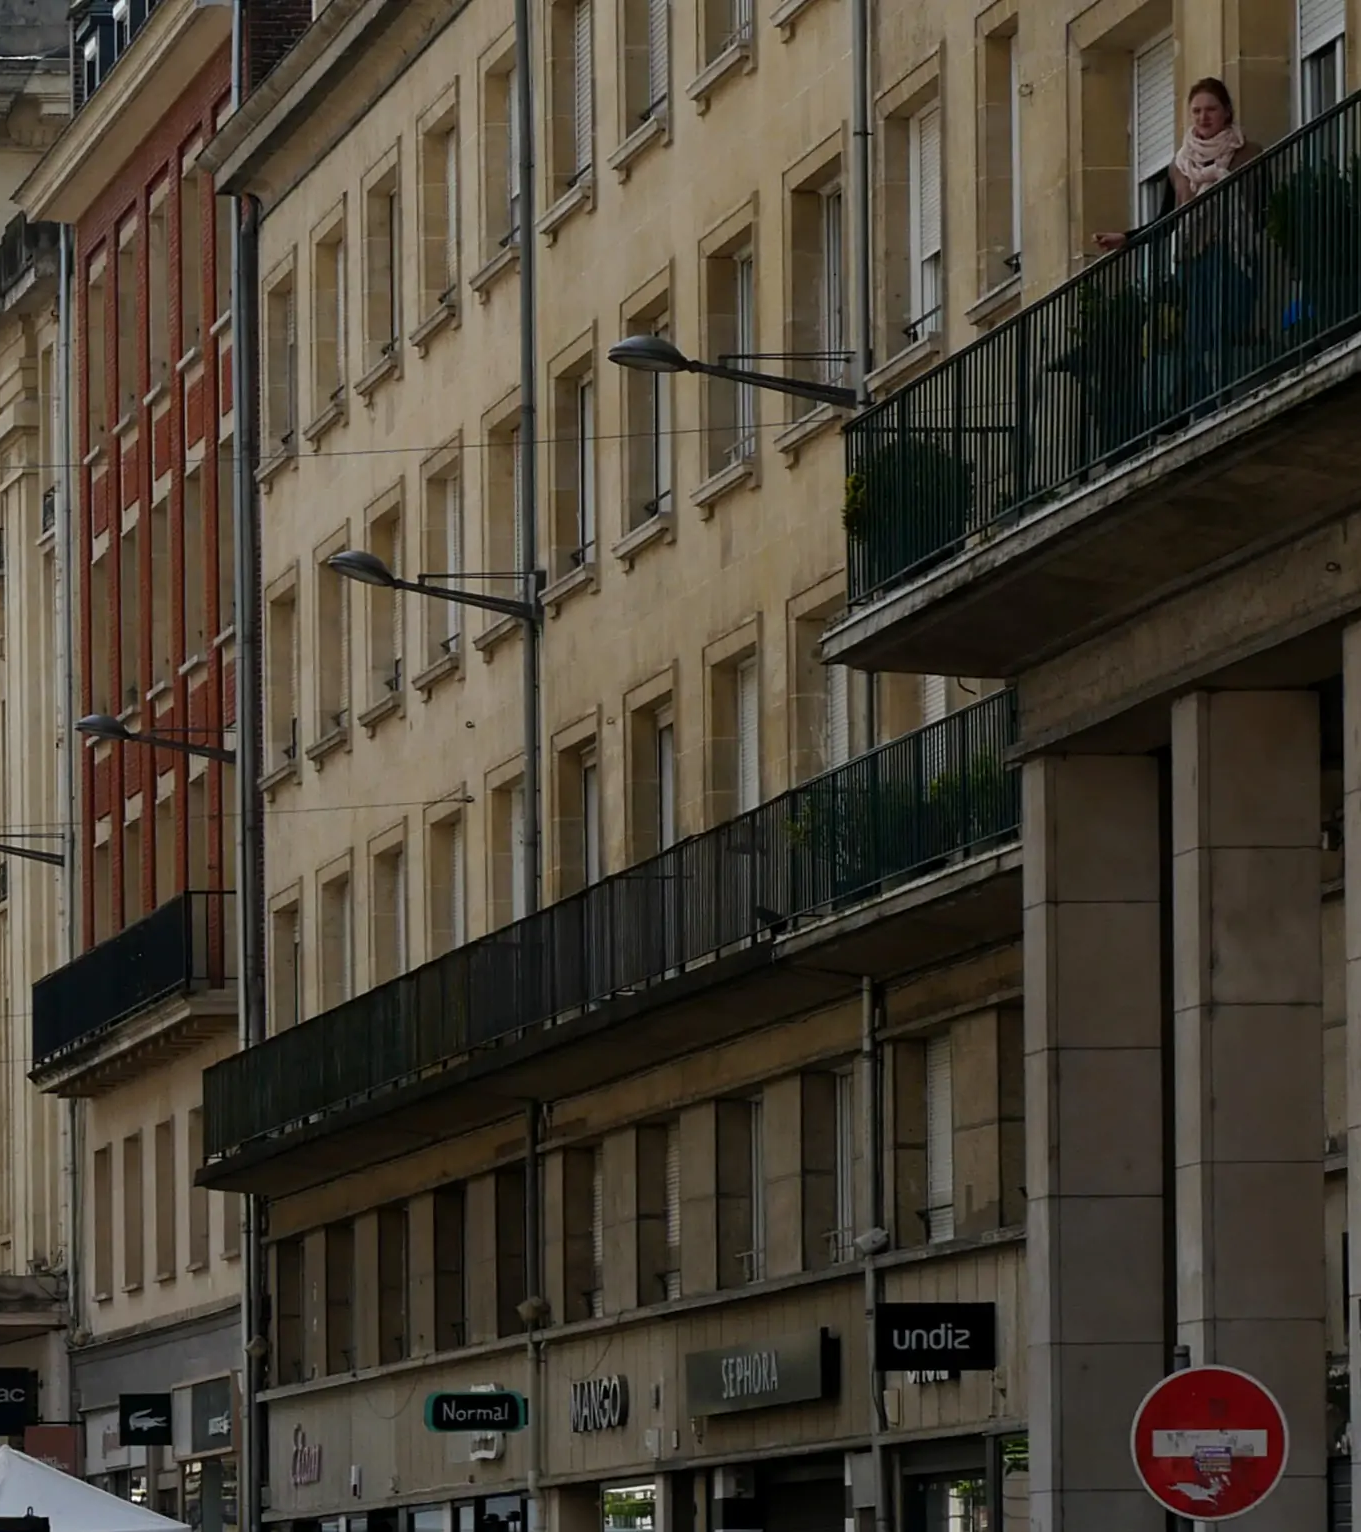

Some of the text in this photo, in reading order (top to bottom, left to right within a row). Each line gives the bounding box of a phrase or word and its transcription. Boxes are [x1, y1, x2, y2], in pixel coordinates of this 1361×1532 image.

[893, 1323, 970, 1350] undiz
[721, 1350, 778, 1399] SEPHORA
[442, 1401, 509, 1422] Normal
[570, 1374, 624, 1432] MANGO
